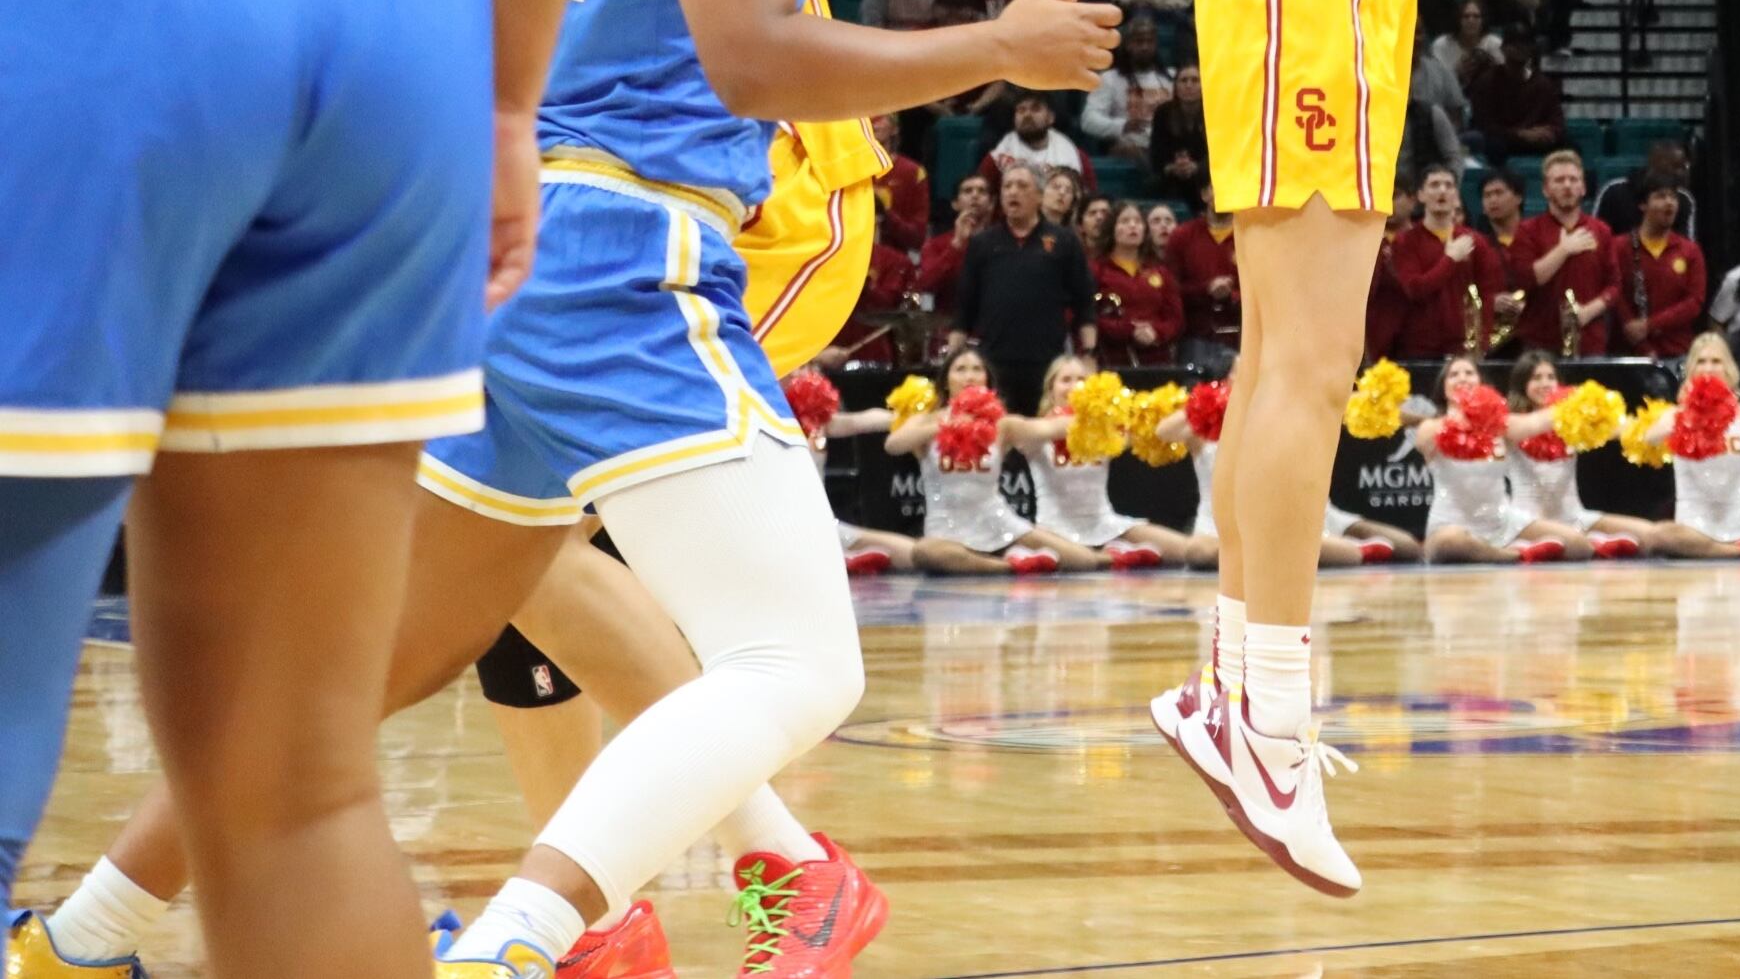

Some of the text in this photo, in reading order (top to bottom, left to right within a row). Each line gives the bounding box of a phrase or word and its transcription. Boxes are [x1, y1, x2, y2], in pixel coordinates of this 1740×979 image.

[1295, 87, 1337, 152] SC
[1358, 467, 1432, 490] MGM
[1369, 495, 1434, 508] GARDE
